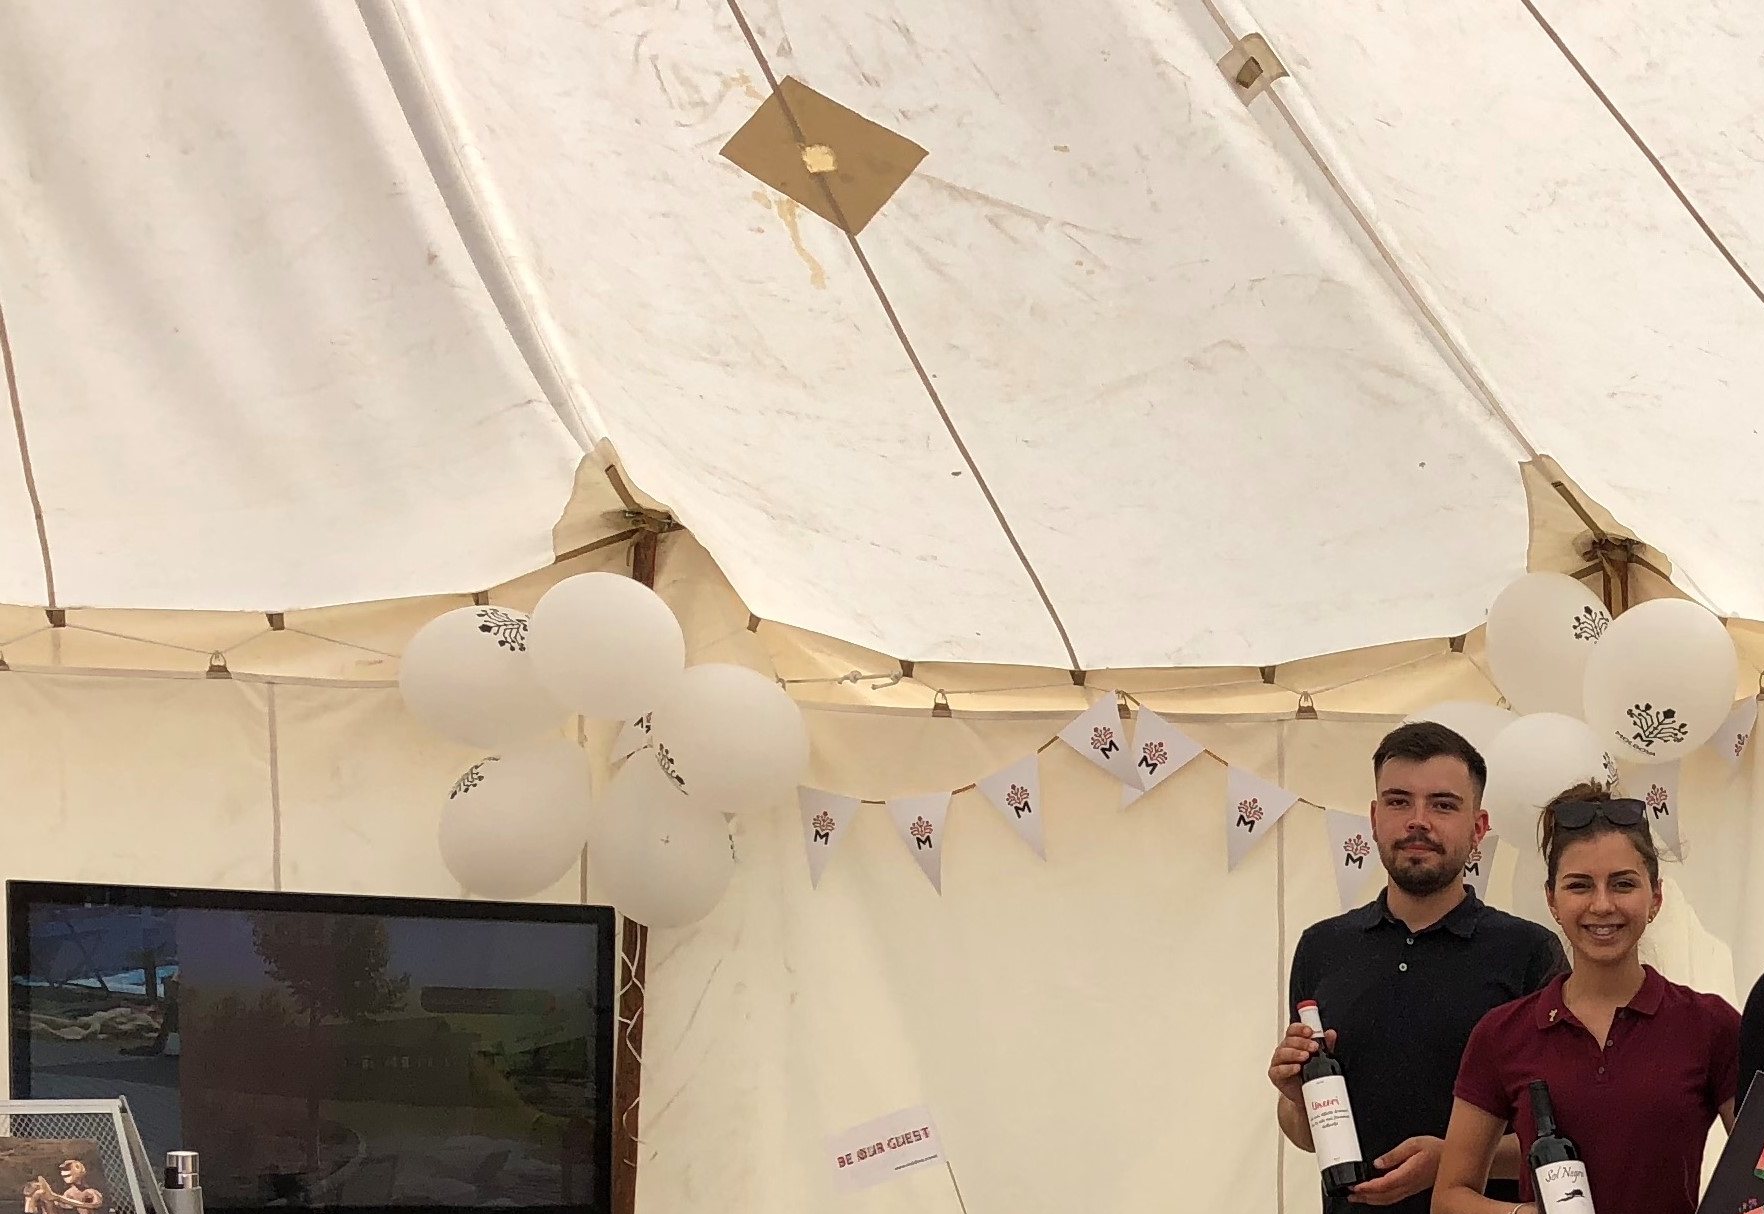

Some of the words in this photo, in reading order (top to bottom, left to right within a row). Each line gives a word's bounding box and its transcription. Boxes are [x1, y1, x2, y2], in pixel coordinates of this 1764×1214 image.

[1100, 740, 1119, 759] M
[1138, 755, 1158, 775] M
[1014, 801, 1032, 818] M
[1653, 803, 1670, 819] M
[1236, 814, 1256, 833] M
[813, 829, 830, 845] M
[916, 835, 933, 850] M
[1345, 853, 1364, 869] M
[837, 1153, 854, 1168] BE
[857, 1142, 885, 1163] OUR
[886, 1127, 930, 1150] GUEST
